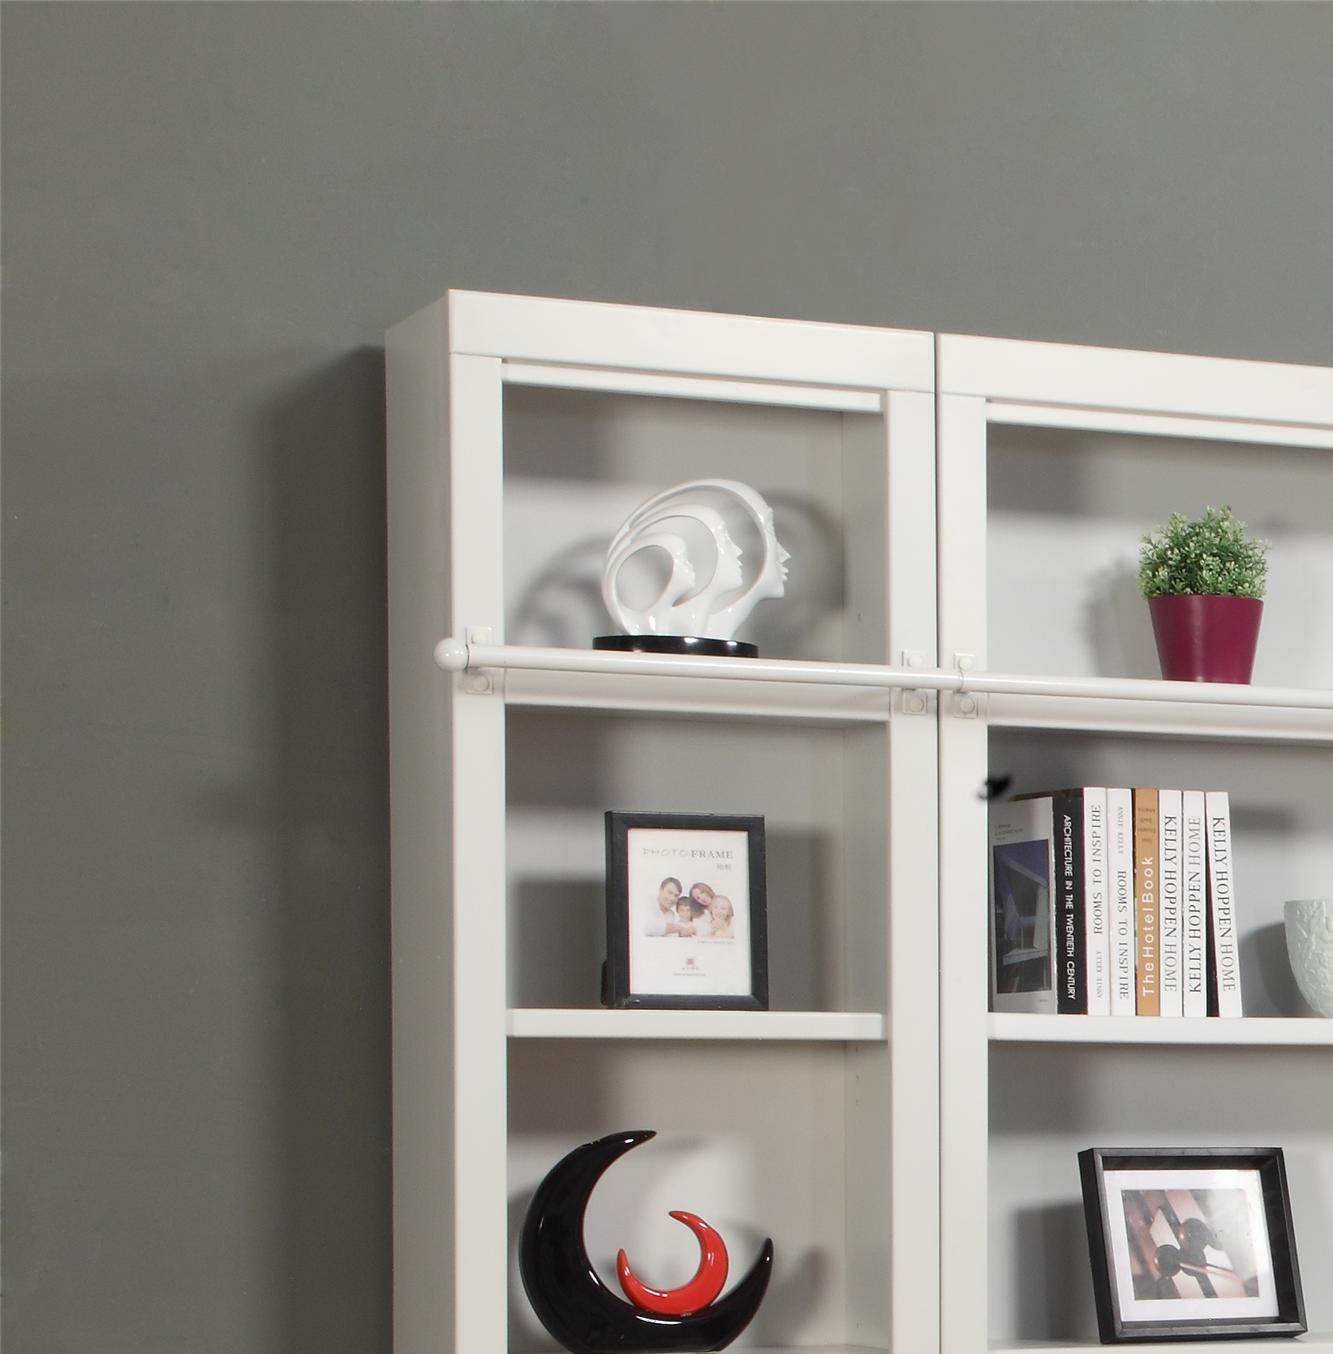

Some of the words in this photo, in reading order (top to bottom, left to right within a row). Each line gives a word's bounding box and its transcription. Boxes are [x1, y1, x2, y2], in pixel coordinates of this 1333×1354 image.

[691, 849, 733, 859] FRAME
[1063, 815, 1073, 877] ARCHITECTURE
[1092, 805, 1102, 864] INSPIRE
[1164, 816, 1177, 866] KELLY
[1188, 818, 1201, 866] HOME
[1212, 817, 1227, 866] KELLY
[1065, 880, 1073, 890] IN
[1093, 869, 1102, 884] TO
[1117, 871, 1127, 913] ROOMS
[1065, 894, 1074, 909] THE
[1094, 891, 1103, 934] ROOMS
[1164, 870, 1177, 938] HOPPEN
[1189, 872, 1201, 939] HOPPEN
[1216, 870, 1232, 938] HOPPEN
[1066, 914, 1075, 958] TWENTIETH
[1118, 920, 1128, 935] TO
[1066, 960, 1076, 1000] CENTURY
[1119, 941, 1128, 1000] INSPIRE
[1164, 944, 1177, 992] HOME
[1189, 944, 1201, 993] KELLY
[1221, 944, 1236, 992] HOME
